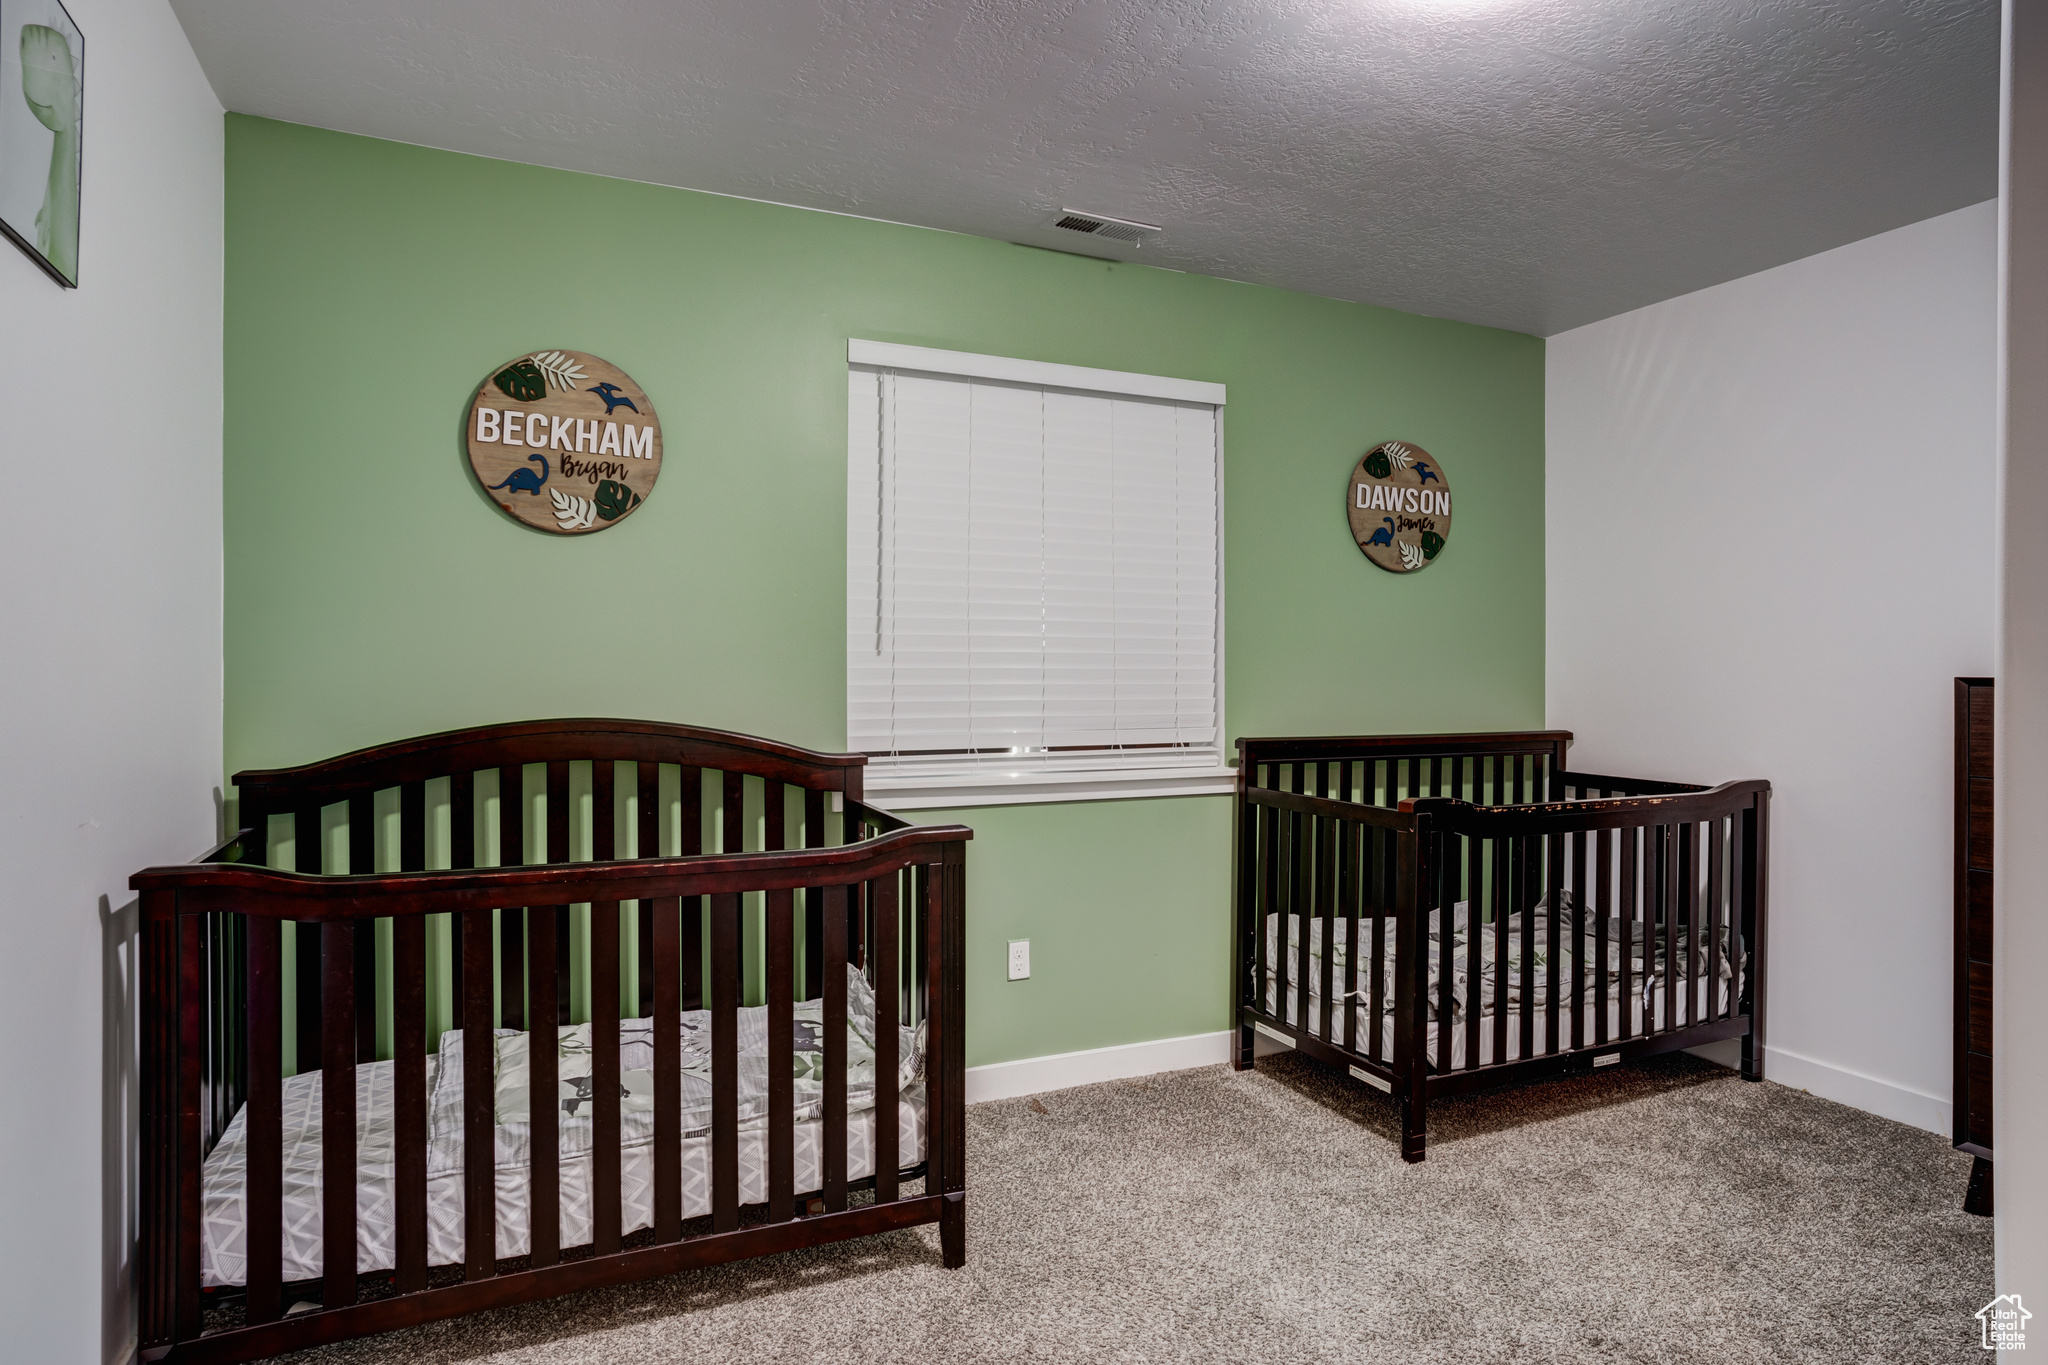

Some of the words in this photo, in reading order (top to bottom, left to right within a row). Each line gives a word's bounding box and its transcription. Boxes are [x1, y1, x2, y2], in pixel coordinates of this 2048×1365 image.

[476, 407, 654, 460] BECKHAM
[560, 452, 629, 484] Bryan
[1356, 483, 1449, 516] DAWSON
[1397, 514, 1435, 533] James
